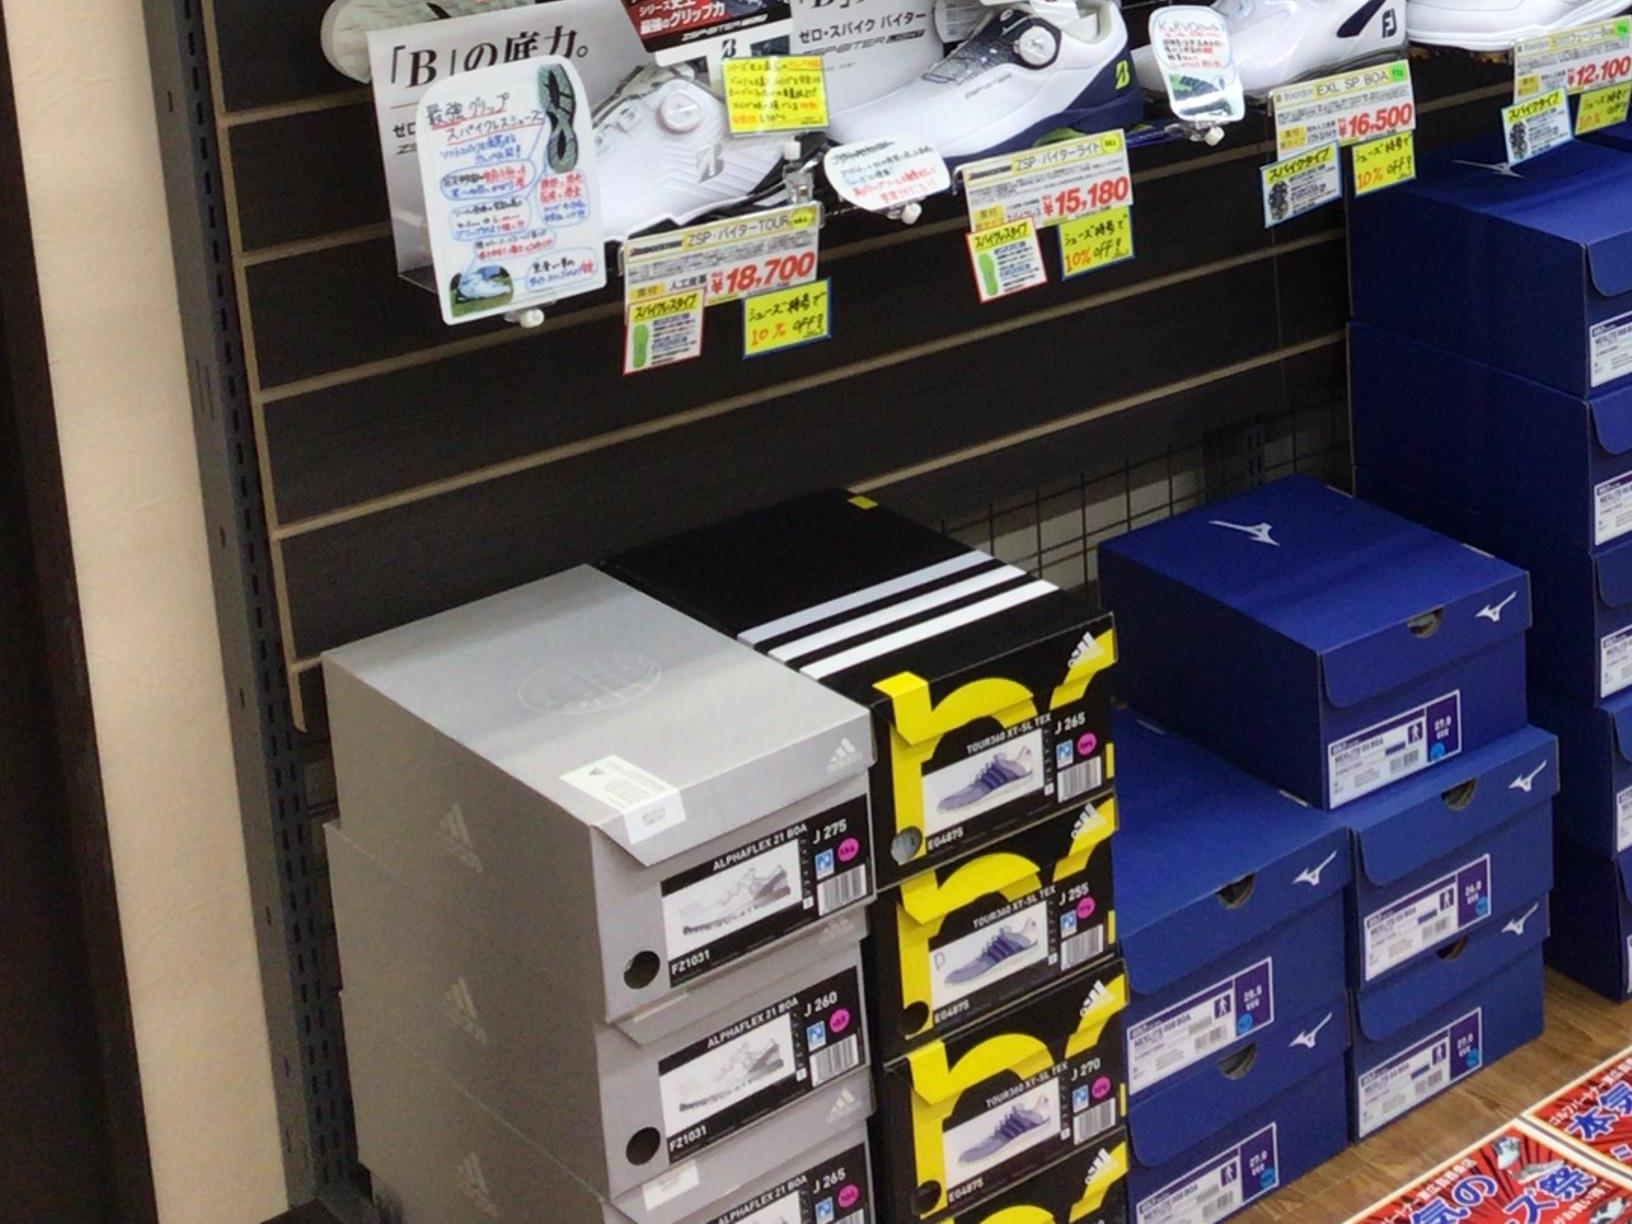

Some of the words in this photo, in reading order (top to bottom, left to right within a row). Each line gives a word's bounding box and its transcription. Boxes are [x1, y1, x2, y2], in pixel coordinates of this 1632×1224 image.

[880, 9, 927, 34] バイター
[1316, 81, 1341, 98] EXL
[1343, 76, 1365, 92] SP
[1366, 69, 1390, 87] BOA
[1567, 54, 1632, 87] ¥12,100
[1337, 103, 1413, 139] ¥16,500
[1041, 175, 1130, 217] ¥15,180
[711, 251, 815, 295] ¥18,700
[966, 731, 1006, 755] TOUR360
[1034, 712, 1053, 727] TEX
[1065, 712, 1086, 730] 265
[812, 830, 821, 844] J
[823, 819, 848, 838] 275
[712, 840, 772, 872] ALPHAFLEX
[774, 831, 786, 844] 21
[786, 823, 808, 839] BOA
[1068, 882, 1090, 900] 255
[671, 949, 711, 976] FZ1031
[803, 1003, 812, 1018] J
[814, 991, 838, 1011] 260
[707, 1015, 764, 1048] ALPHAFLEX
[765, 1007, 777, 1020] 21
[778, 997, 800, 1013] BOA
[1080, 1057, 1101, 1076] 270
[669, 1125, 707, 1152] FZ1031
[822, 1167, 847, 1188] 265
